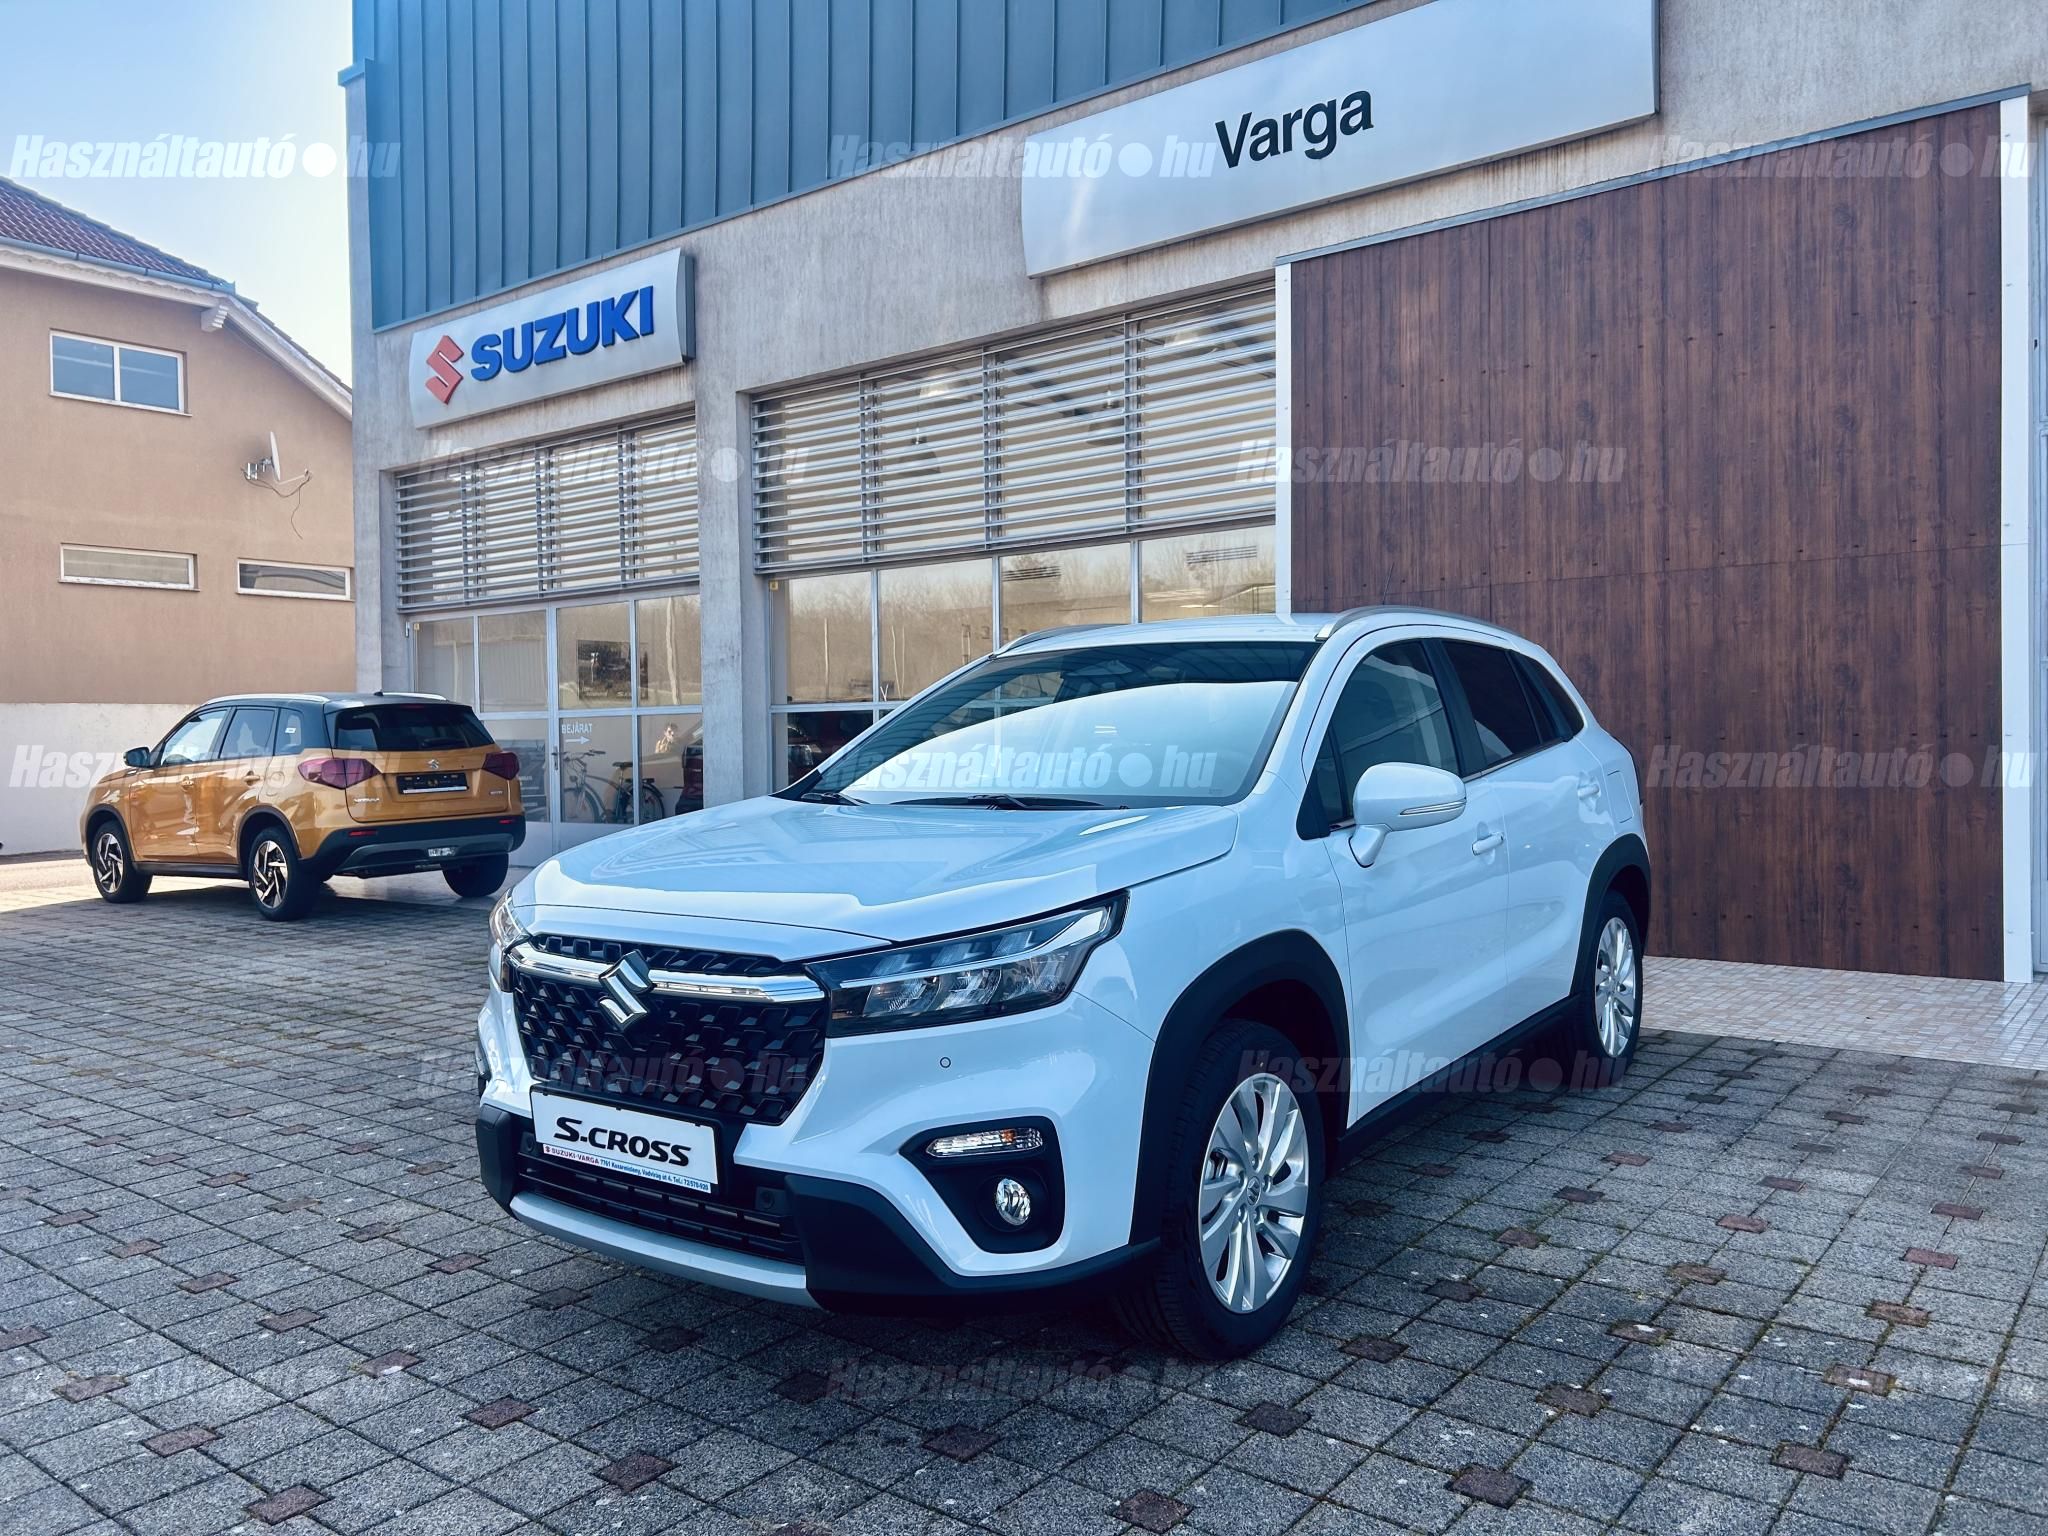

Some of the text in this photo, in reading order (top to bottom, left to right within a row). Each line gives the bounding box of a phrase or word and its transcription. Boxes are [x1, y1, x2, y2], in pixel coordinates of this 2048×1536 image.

[1215, 90, 1373, 169] Varga
[471, 285, 654, 382] SUZUKI
[561, 722, 593, 734] BEJÁRAT
